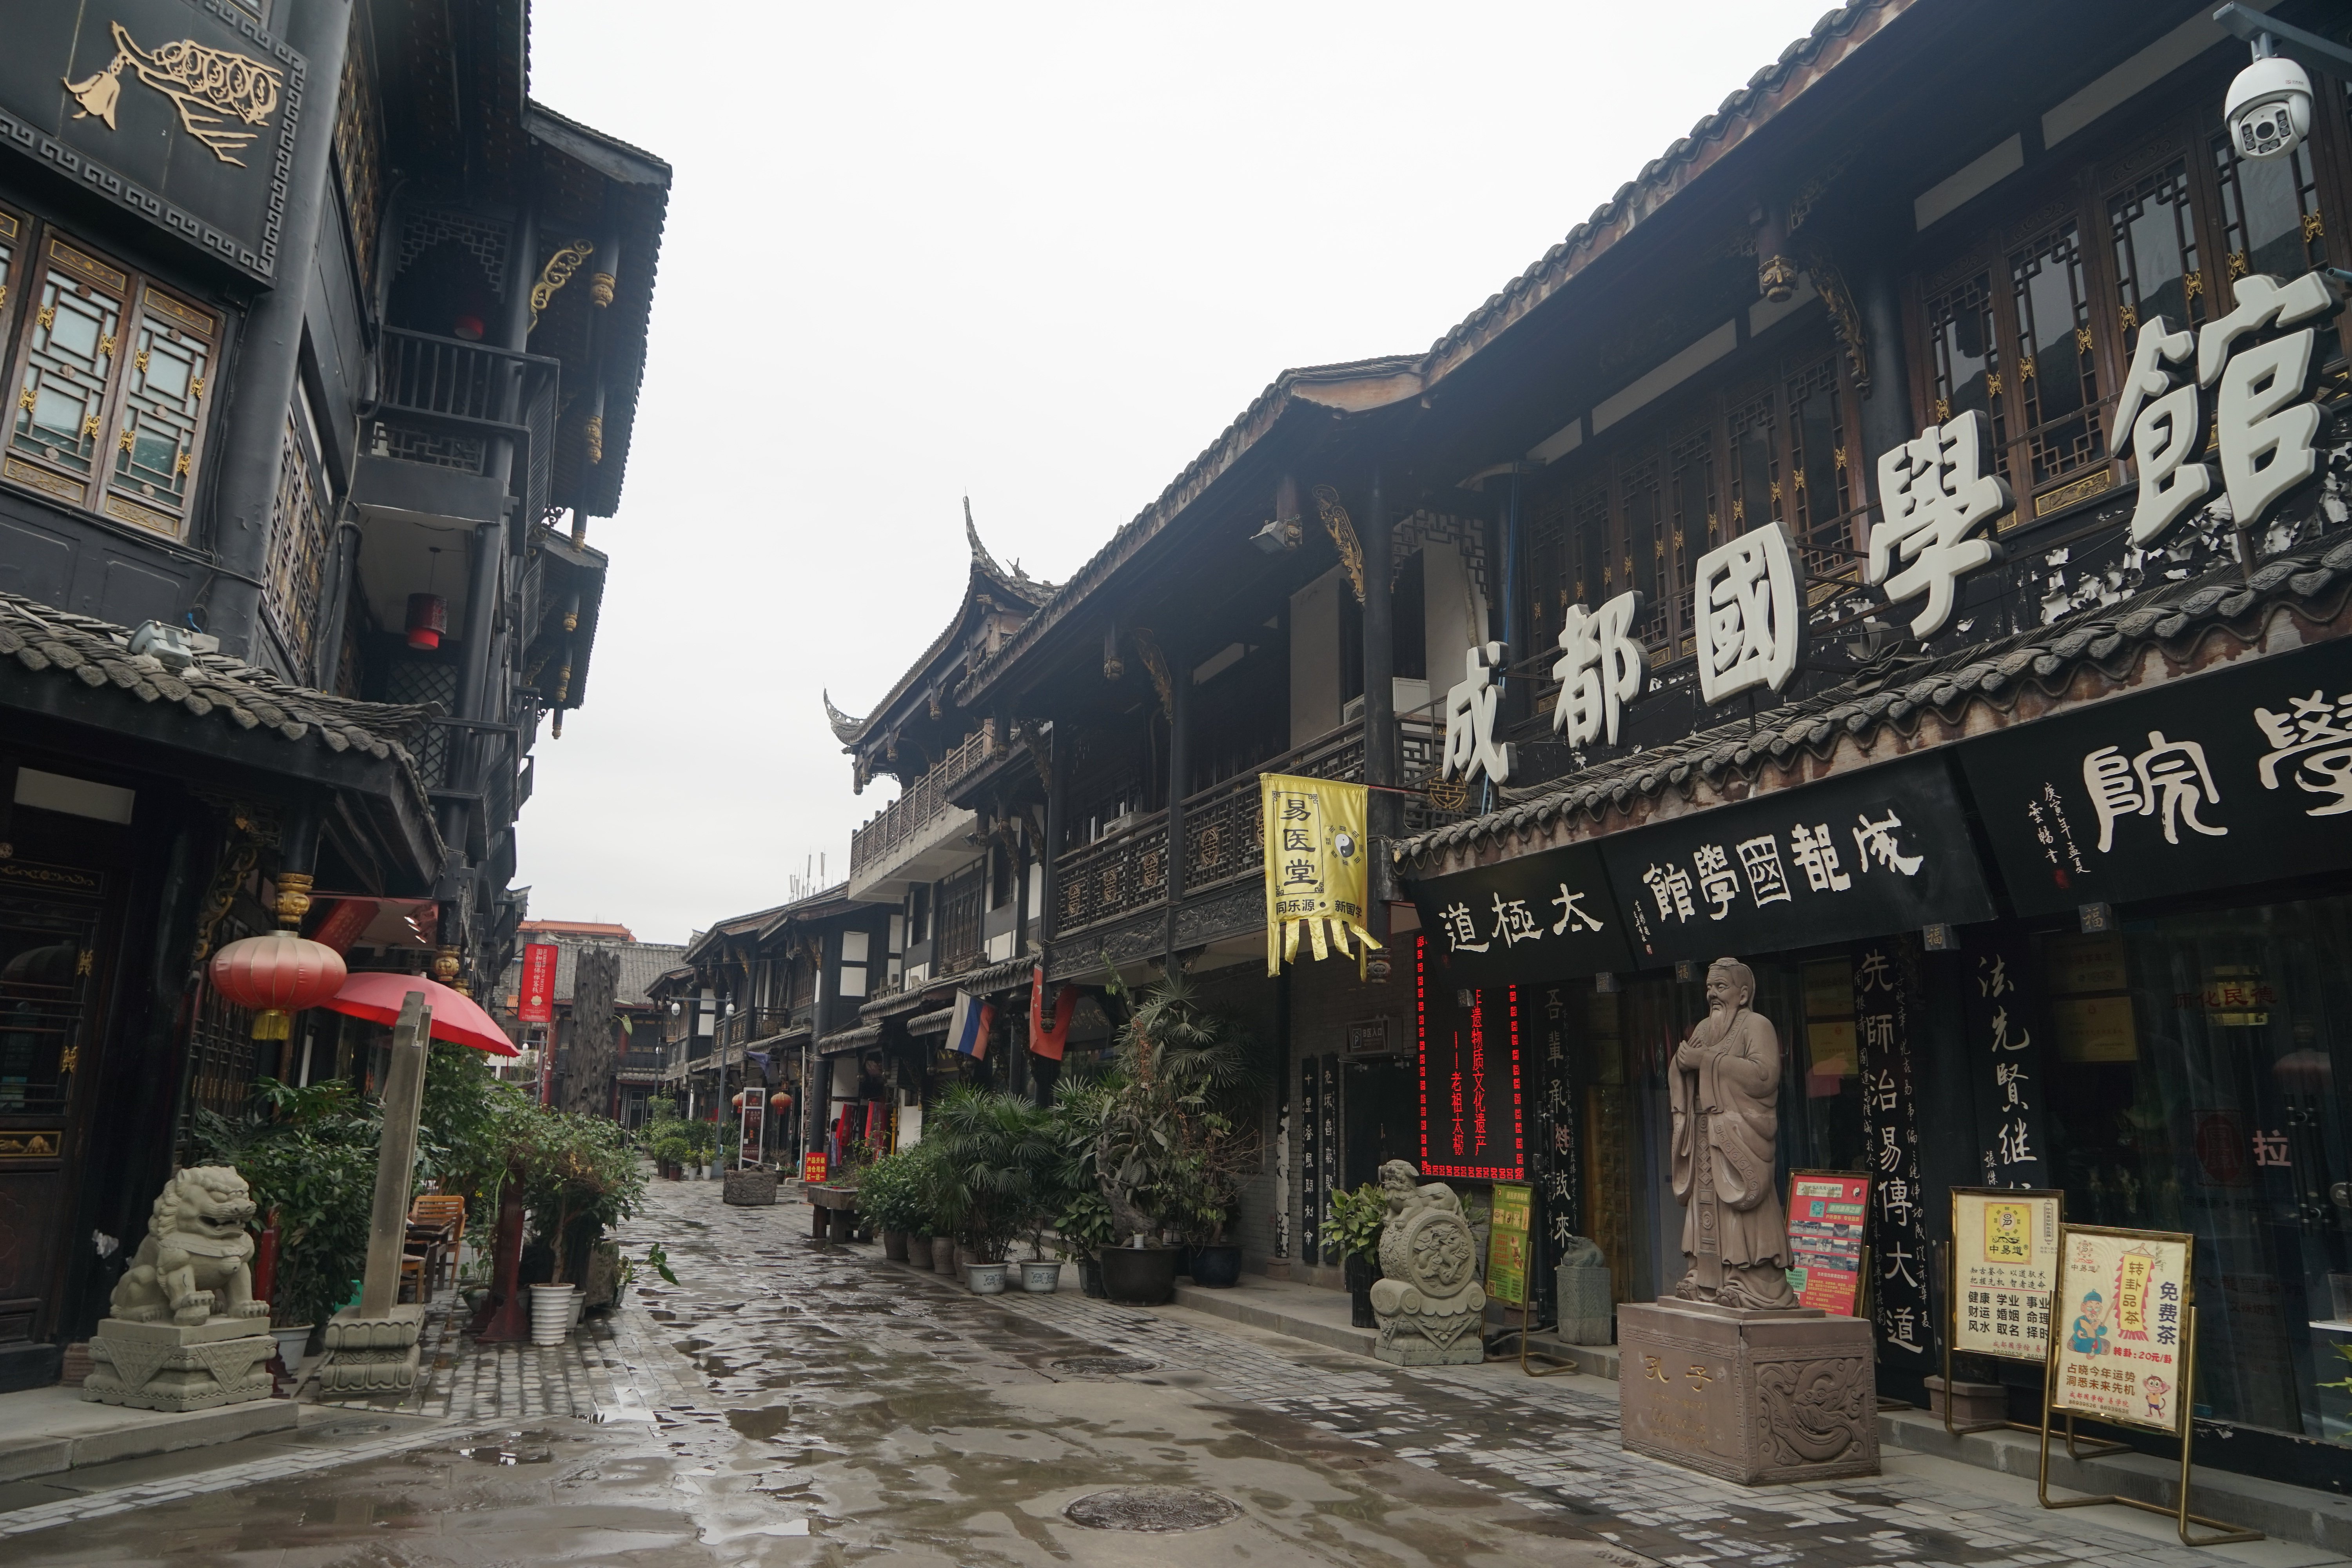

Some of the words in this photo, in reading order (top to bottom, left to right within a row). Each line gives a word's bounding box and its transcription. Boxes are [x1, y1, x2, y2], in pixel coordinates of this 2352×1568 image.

[1441, 274, 2337, 784] 成都國學館
[1280, 799, 1318, 887] 易医堂
[1643, 808, 1924, 924] 成都國學館
[1439, 883, 1603, 953] 太極道
[2082, 907, 2103, 929] 福
[1926, 927, 1942, 946] 福
[1678, 964, 1689, 979] 福
[1363, 1027, 1382, 1038] B区入口
[1977, 955, 2038, 1189] 法先賢继
[1861, 953, 1923, 1354] 先師治易傳大道
[2252, 1130, 2291, 1167] 拉
[1970, 1266, 2005, 1275] 知古鉴今
[2010, 1269, 2046, 1279] 以道驭术
[2071, 1264, 2097, 1273] 中易道
[1970, 1276, 2005, 1287] 把握先机
[2010, 1279, 2046, 1290] 智者造命
[2123, 1261, 2144, 1325] 转卦品茶
[1968, 1291, 1990, 1305] 健康
[1996, 1294, 2020, 1307] 学业
[2026, 1296, 2050, 1309] 事业
[1968, 1305, 1990, 1319] 财运
[1996, 1308, 2020, 1322] 婚姻
[2026, 1311, 2049, 1325] 命理
[2156, 1281, 2179, 1345] 免费茶
[1968, 1320, 1990, 1333] 风水
[1996, 1323, 2020, 1337] 取名
[1993, 1340, 2030, 1351] 成都国学馆
[1644, 1356, 1713, 1392] 孔子
[2067, 1363, 2136, 1383] 占晓今年运势
[2066, 1375, 2135, 1396] 洞悉未来先机
[2069, 1391, 2104, 1403] 成都国学馆
